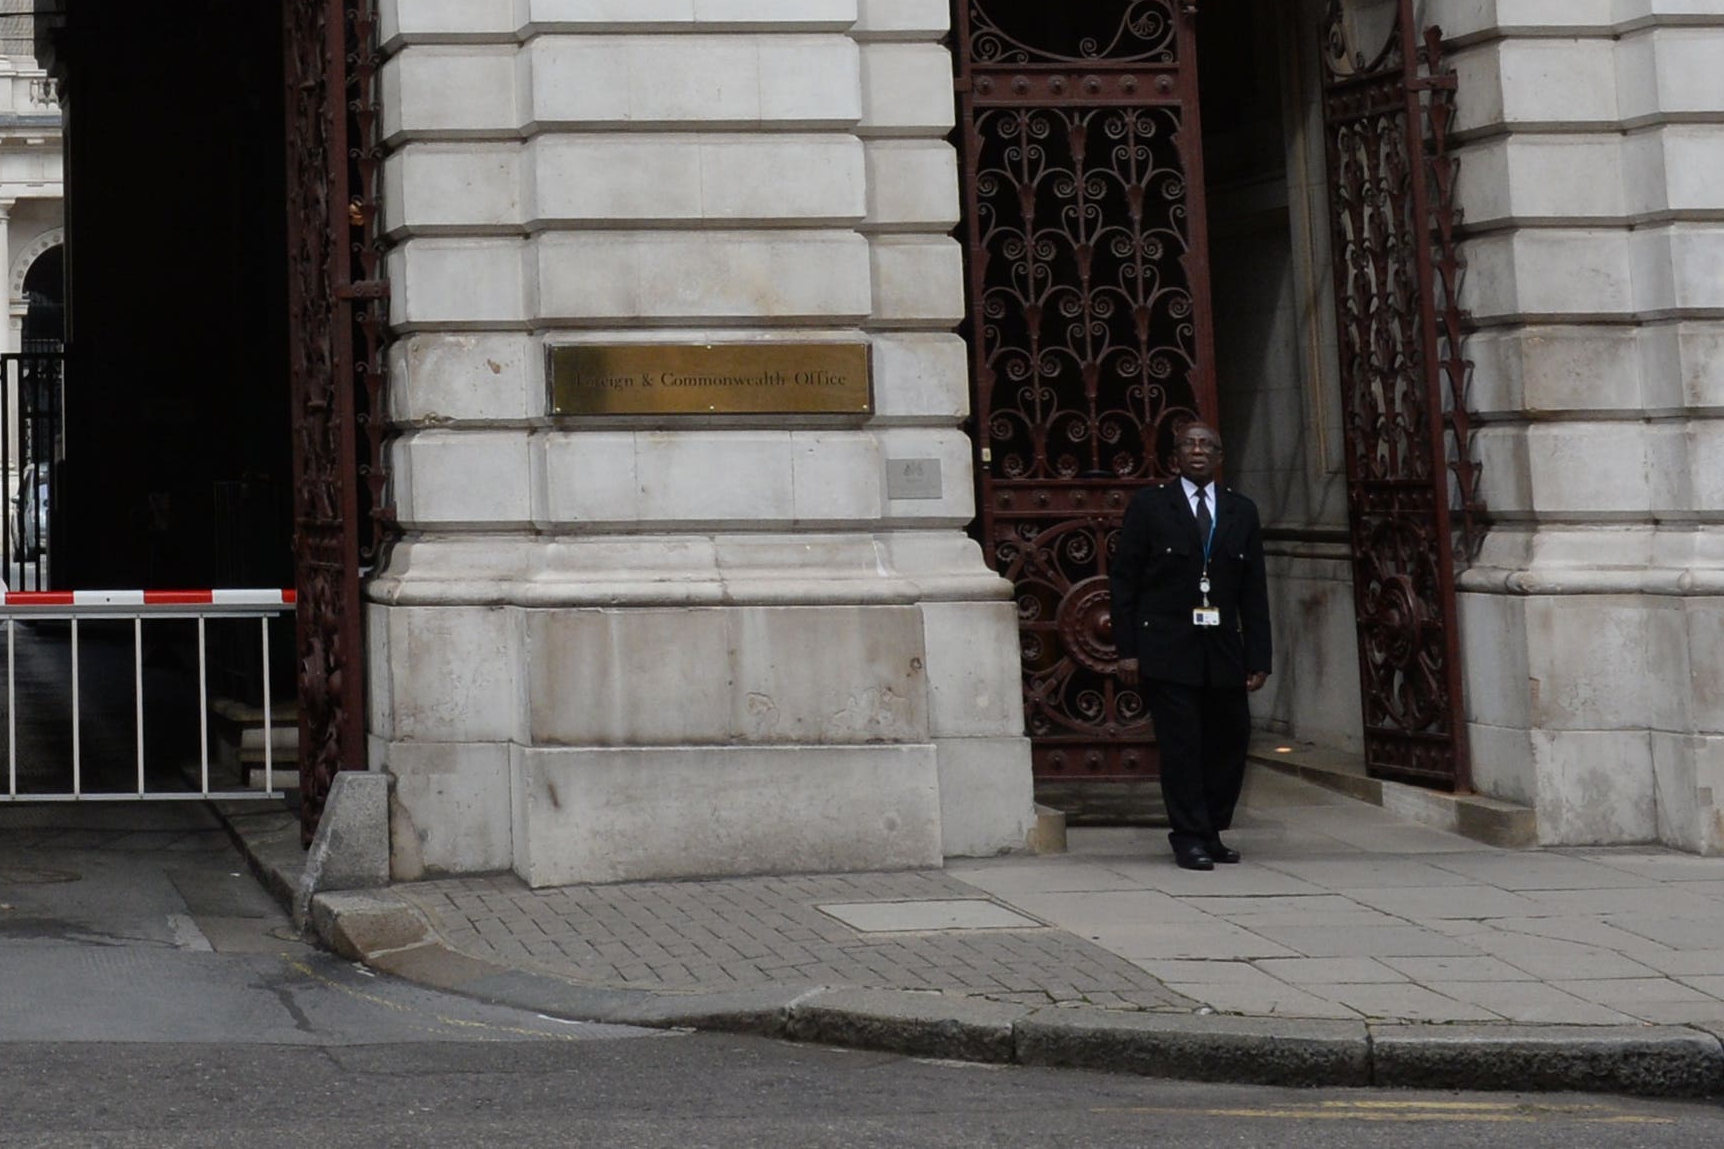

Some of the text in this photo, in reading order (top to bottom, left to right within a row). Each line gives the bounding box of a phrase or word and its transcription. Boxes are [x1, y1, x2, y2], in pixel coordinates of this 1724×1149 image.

[641, 372, 653, 387] &
[660, 371, 786, 387] Commonwealth
[794, 370, 847, 386] Office
